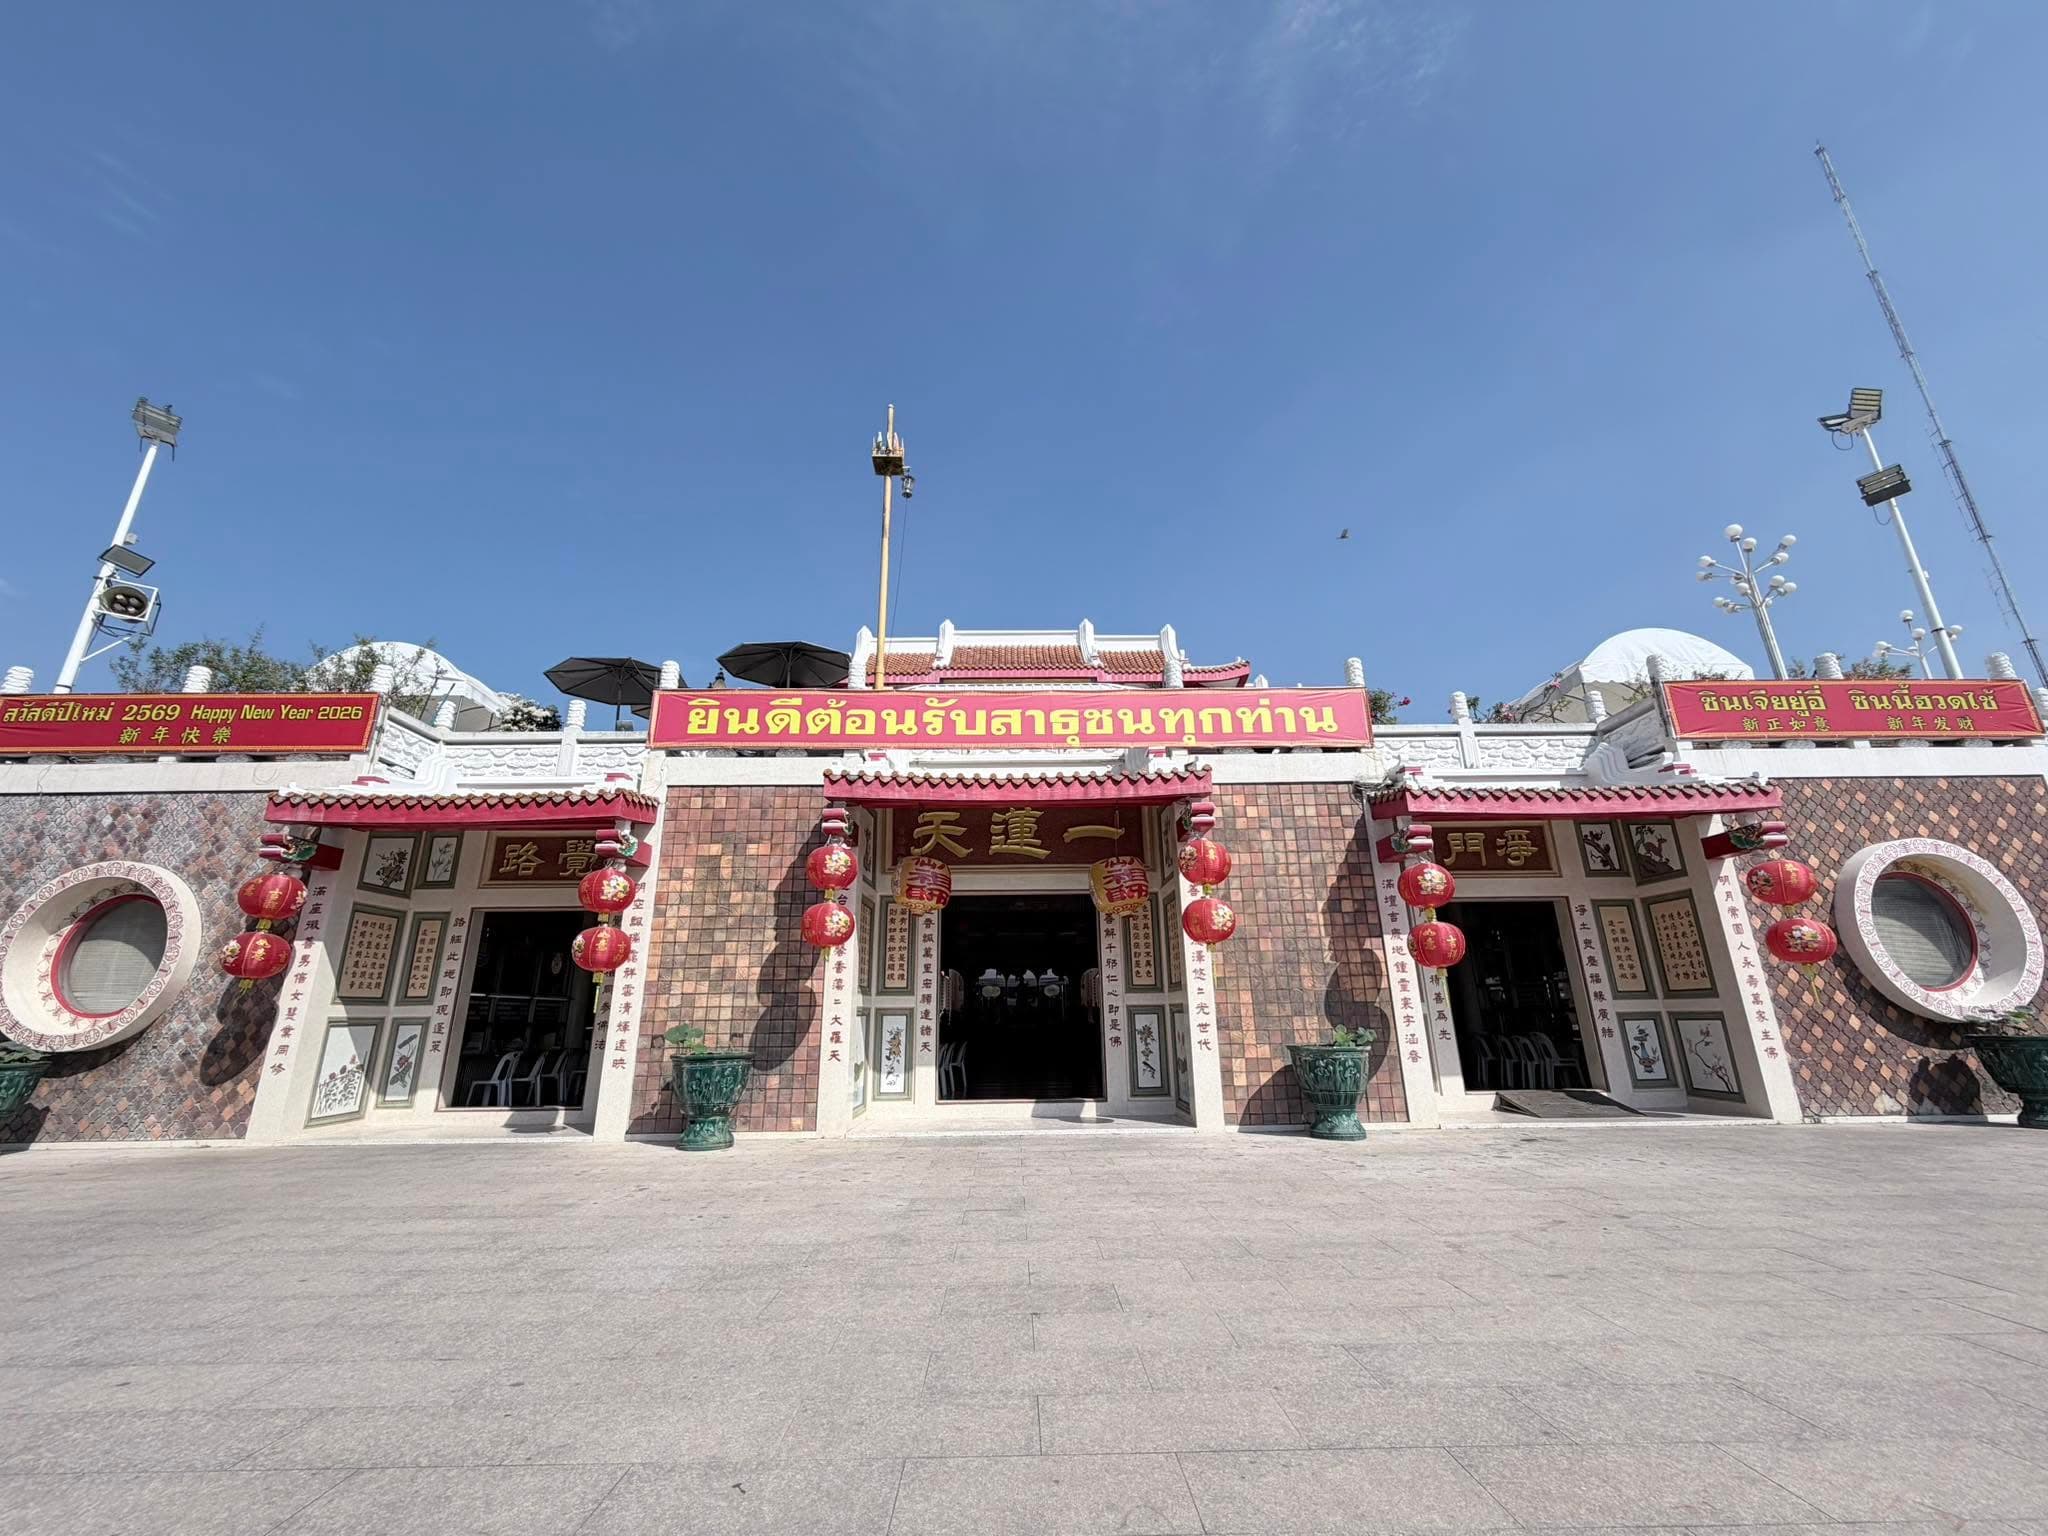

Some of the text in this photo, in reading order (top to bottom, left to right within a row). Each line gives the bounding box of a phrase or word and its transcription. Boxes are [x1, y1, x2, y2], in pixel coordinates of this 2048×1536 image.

[3, 701, 363, 723] สวัสดีปีใหม่ 2569 Happy New Year 2026
[686, 697, 1338, 746] ยินดีต้อนรับสาธุชนทุกท่าน
[1742, 716, 1830, 732] 新正如意
[118, 725, 232, 744] 新年快樂
